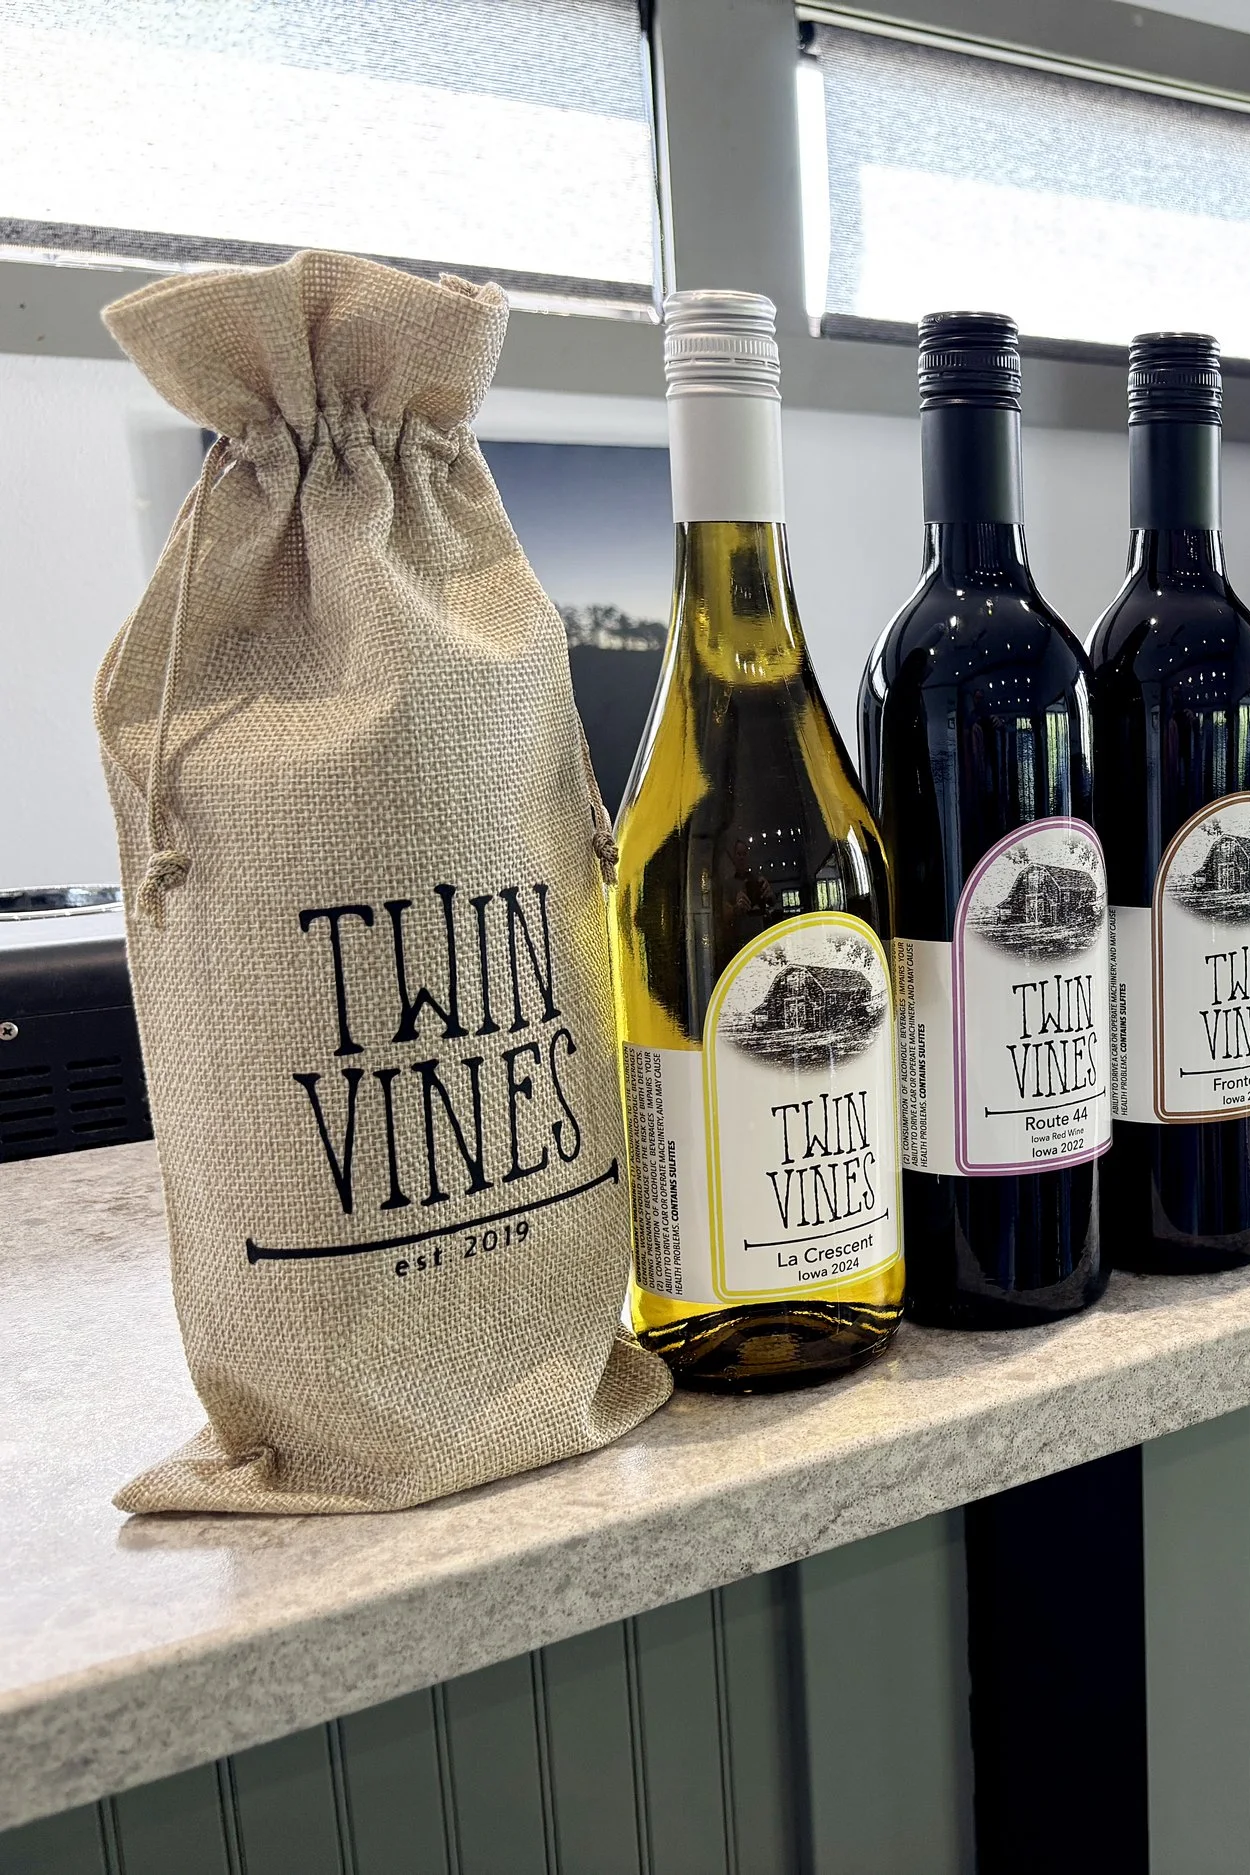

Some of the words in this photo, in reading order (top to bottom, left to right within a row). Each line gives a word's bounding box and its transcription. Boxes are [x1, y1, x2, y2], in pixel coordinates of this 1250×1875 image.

[897, 941, 905, 962] YOUR
[906, 943, 914, 967] CAUSE
[299, 883, 562, 1057] TWIN
[898, 965, 906, 995] IMPAIRS
[907, 984, 915, 1001] AND
[1012, 974, 1093, 1039] TWIN
[1119, 983, 1127, 1016] SULFITES
[899, 998, 907, 1039] BEVERAGES
[908, 1001, 916, 1045] MACHINERY,
[917, 1023, 926, 1059] SULFITES
[629, 1048, 637, 1092] BEVERAGES
[636, 1050, 644, 1085] DEFECTS.
[644, 1051, 652, 1074] YOUR
[653, 1052, 661, 1079] CAUSE
[900, 1042, 908, 1083] ALCOHOLIC
[1006, 1031, 1097, 1099] VINES
[1120, 1053, 1128, 1091] PROBLEMS.
[646, 1077, 654, 1109] IMPAIRS
[901, 1084, 908, 1095] OF
[909, 1077, 916, 1088] OR
[918, 1059, 926, 1099] CONTAINS
[638, 1087, 646, 1110] BIRTH
[656, 1098, 664, 1116] AND
[1120, 1091, 1128, 1116] HEALTH
[1222, 1092, 1245, 1105] Iowa
[293, 1028, 581, 1215] VINES
[639, 1113, 646, 1123] OF
[771, 1090, 871, 1165] TWIN
[901, 1098, 909, 1151] CONSUMPTION
[919, 1100, 927, 1141] PROBLEMS.
[1025, 1112, 1070, 1132] Route
[1073, 1108, 1088, 1123] 44
[648, 1113, 656, 1157] BEVERAGES
[657, 1116, 666, 1164] MACHINERY,
[911, 1131, 917, 1141] TO
[1031, 1132, 1050, 1143] Iowa
[1052, 1130, 1065, 1140] Red
[1067, 1126, 1084, 1138] Wine
[1032, 1143, 1059, 1158] Iowa
[1061, 1137, 1084, 1153] 2022
[642, 1162, 649, 1173] OF
[668, 1140, 677, 1178] SULFITES
[902, 1154, 910, 1165] (2)
[920, 1141, 928, 1168] HEALTH
[643, 1176, 651, 1209] BECAUSE
[649, 1160, 658, 1204] ALCOHOLIC
[659, 1164, 667, 1198] OPERATE
[766, 1151, 876, 1229] VINES
[652, 1206, 659, 1217] OF
[660, 1198, 668, 1210] OR
[670, 1179, 679, 1222] CONTAINS
[638, 1219, 646, 1248] WOMEN
[645, 1211, 653, 1256] PREGNANCY
[661, 1210, 669, 1226] CAR
[463, 1221, 531, 1259] 2019
[653, 1220, 663, 1277] CONSUMPTION
[662, 1231, 670, 1256] DRIVE
[672, 1223, 682, 1266] PROBLEMS.
[777, 1251, 798, 1268] La
[804, 1233, 874, 1265] Crescent
[647, 1259, 655, 1289] DURING
[664, 1256, 671, 1266] TO
[797, 1266, 828, 1282] Iowa
[831, 1257, 860, 1276] 2024
[664, 1266, 672, 1294] ABILITY
[674, 1267, 683, 1296] HEALTH
